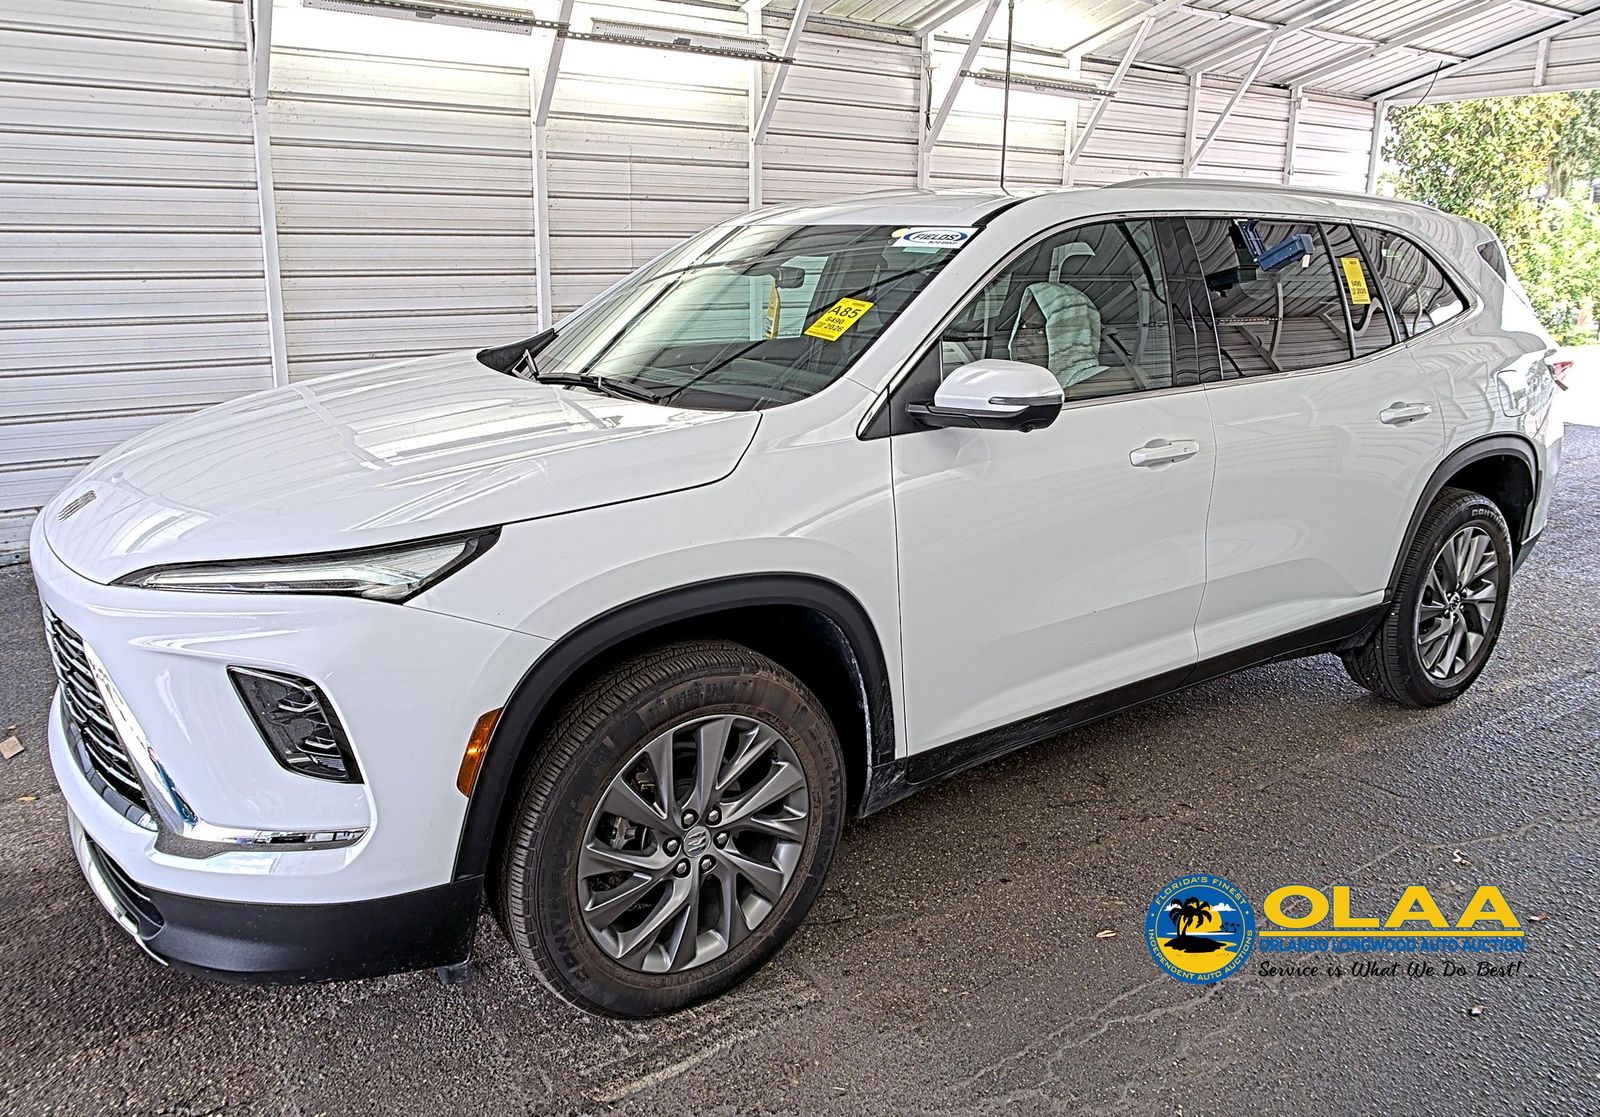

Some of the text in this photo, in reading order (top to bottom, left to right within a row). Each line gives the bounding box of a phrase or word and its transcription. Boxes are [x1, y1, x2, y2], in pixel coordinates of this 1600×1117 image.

[912, 233, 959, 241] FIELDS
[828, 305, 861, 319] A85
[824, 323, 845, 332] 2026
